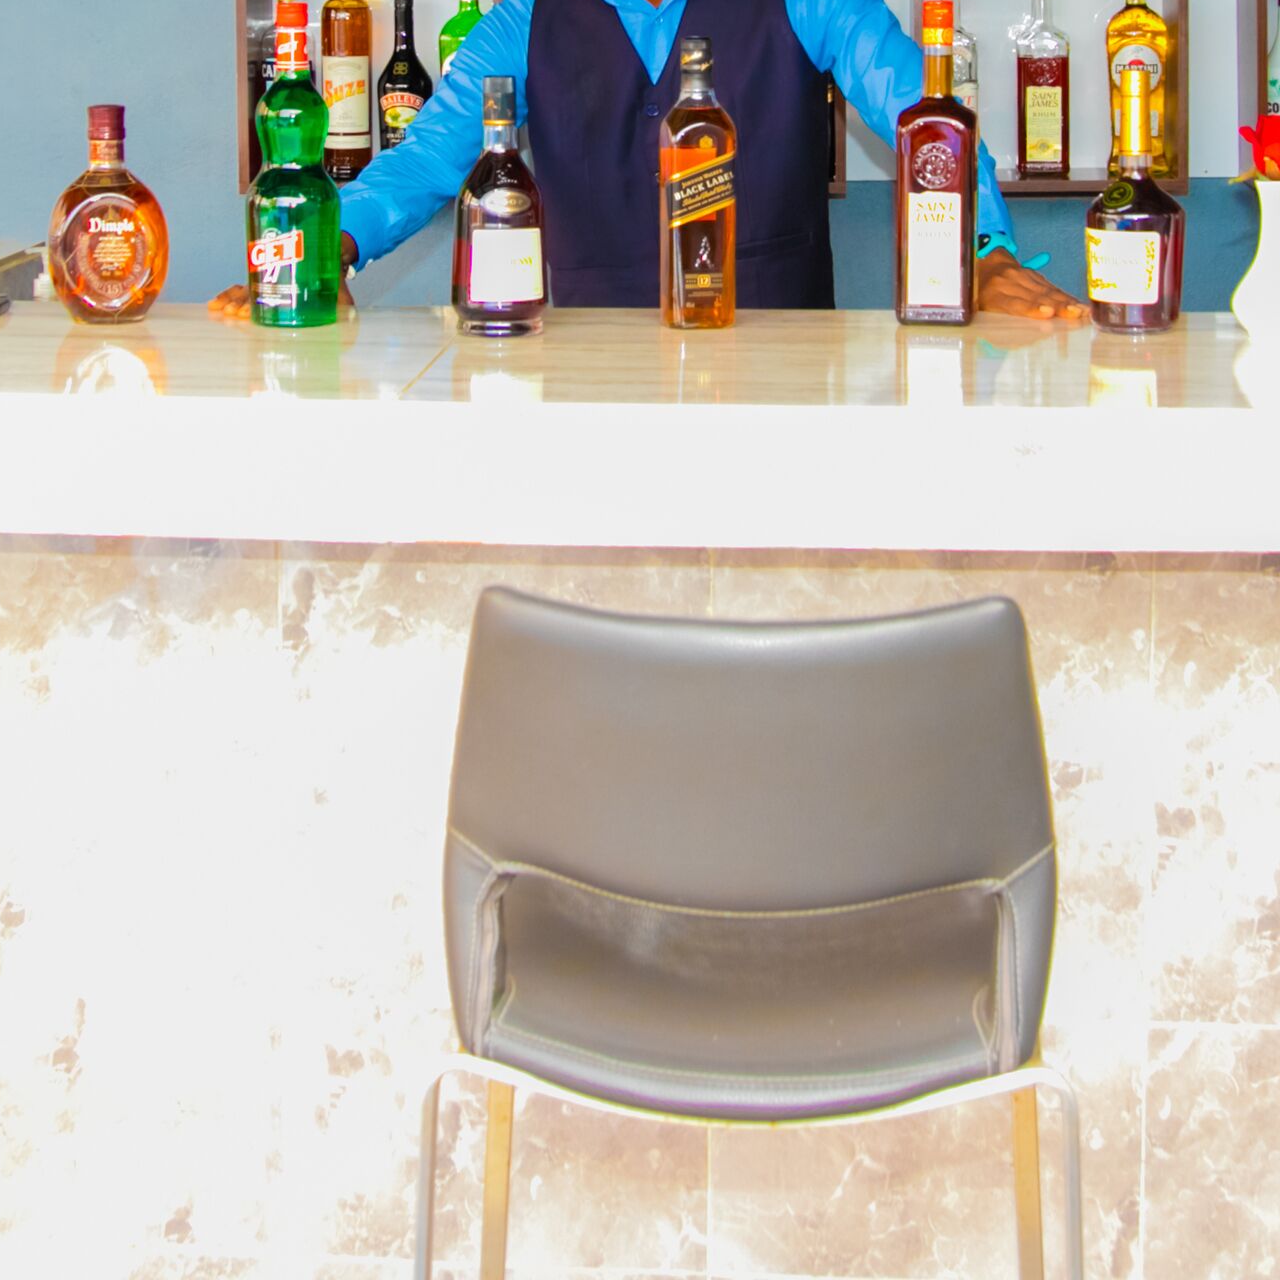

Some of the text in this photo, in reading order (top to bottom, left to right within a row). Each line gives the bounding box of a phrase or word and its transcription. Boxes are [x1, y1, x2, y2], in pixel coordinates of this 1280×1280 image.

[381, 94, 421, 107] BAILEYS
[1031, 91, 1058, 101] SAINT
[1028, 100, 1059, 109] JAMES
[673, 171, 734, 201] BLACK LABEL
[915, 201, 954, 212] SAINT
[915, 213, 957, 223] JAMES
[88, 216, 135, 235] Dimple
[250, 234, 298, 266] GET
